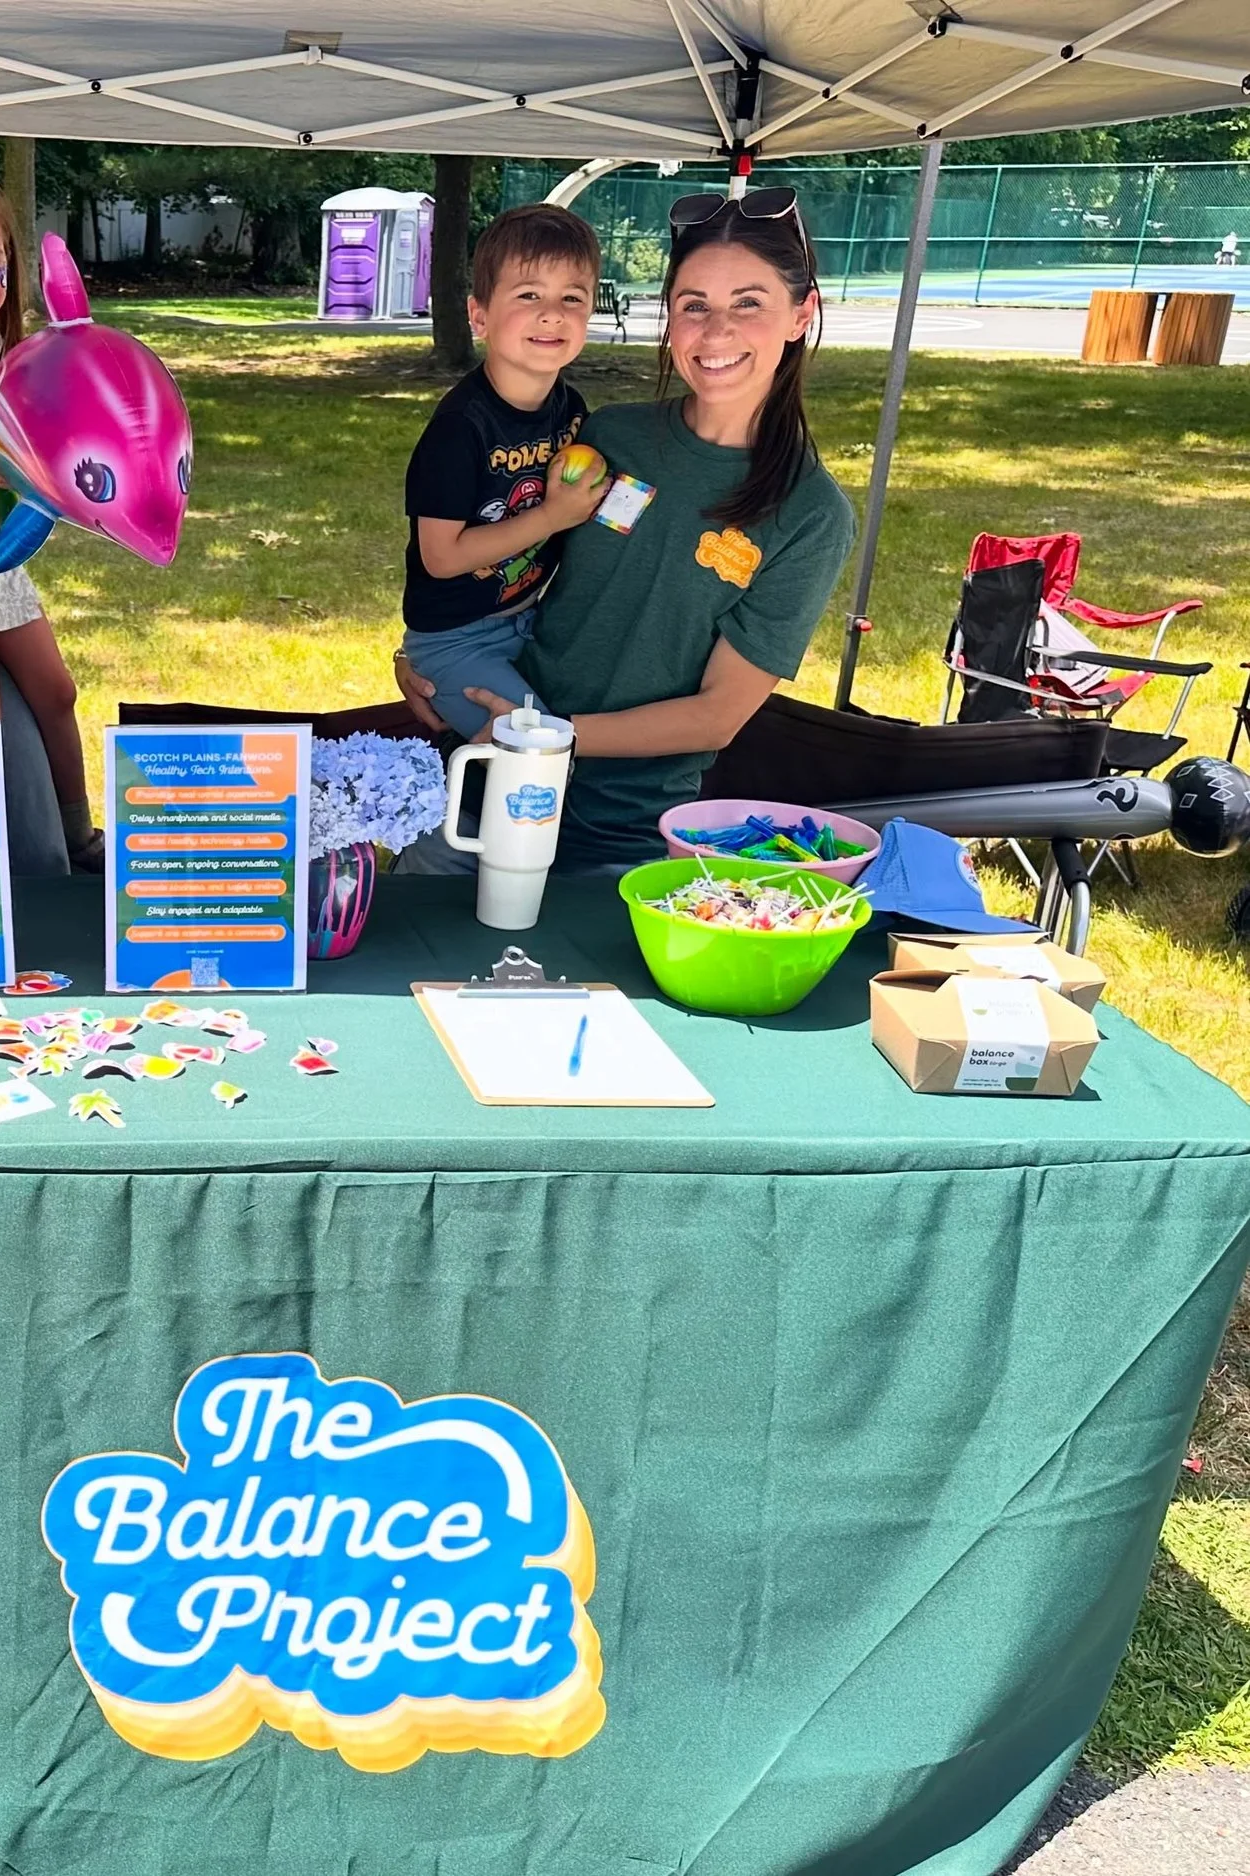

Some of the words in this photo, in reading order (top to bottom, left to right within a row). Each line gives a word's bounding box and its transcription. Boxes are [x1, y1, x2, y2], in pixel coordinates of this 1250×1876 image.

[490, 441, 554, 472] POWE
[703, 536, 751, 568] Balance
[133, 753, 180, 762] SCOTCH
[144, 763, 188, 777] Healthy
[190, 764, 215, 775] Tech
[508, 795, 551, 805] Balance
[129, 814, 155, 823] Delay
[157, 814, 209, 824] smartphones
[211, 814, 228, 822] and
[229, 813, 253, 822] social
[130, 860, 160, 869] Foster
[186, 860, 220, 870] ongoing
[221, 859, 280, 868] conversations
[146, 906, 166, 916] Stay
[168, 906, 203, 916] engaged
[204, 905, 220, 914] and
[222, 905, 264, 915] adaptable
[971, 1049, 1015, 1057] balance
[969, 1057, 989, 1065] box
[202, 1376, 532, 1523] The
[73, 1474, 492, 1566] Balance
[100, 1574, 552, 1680] Project
